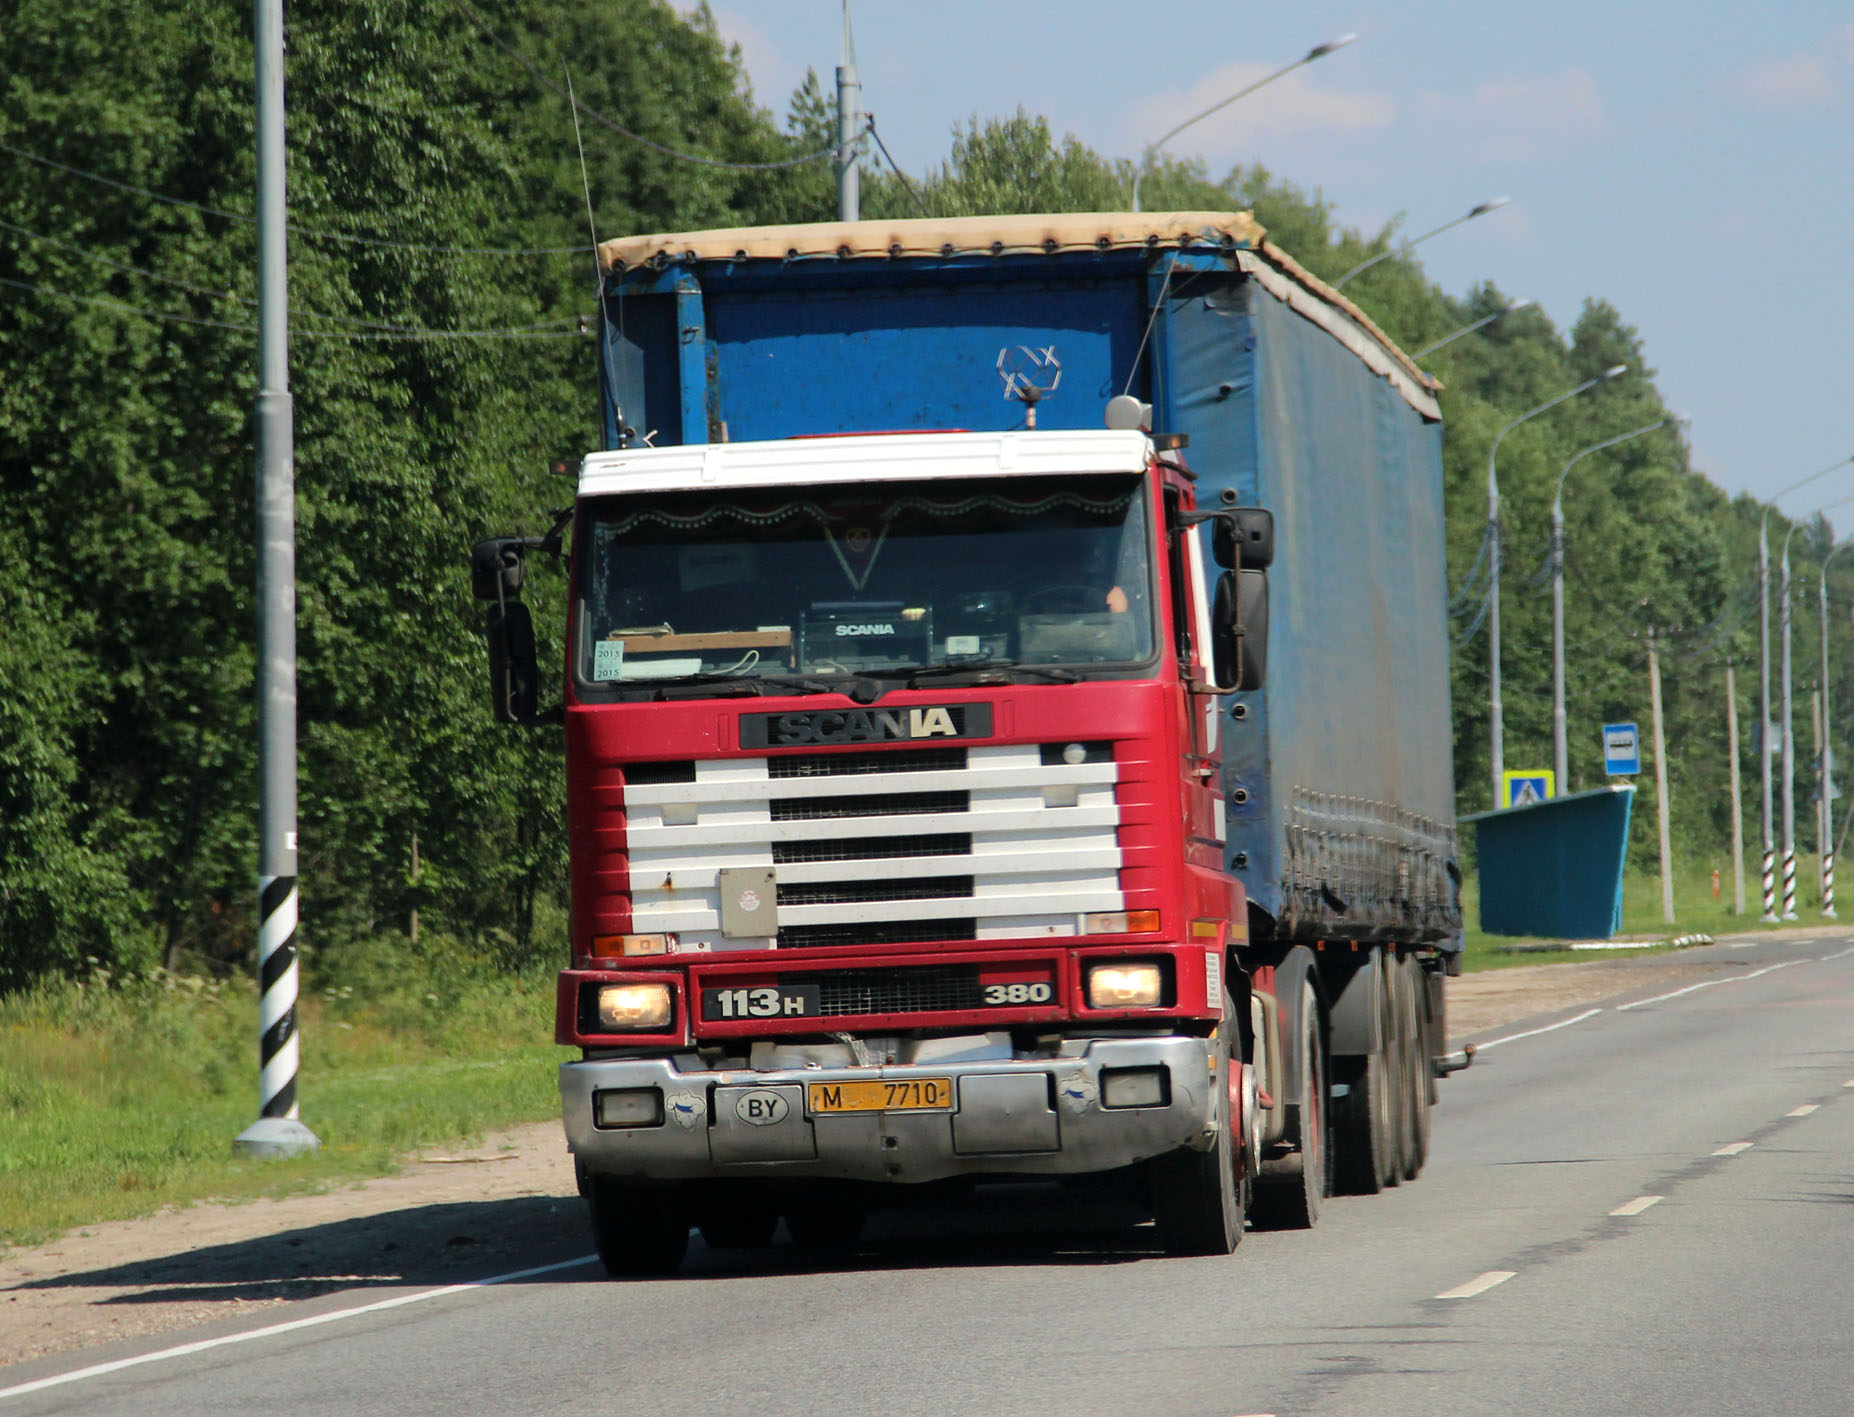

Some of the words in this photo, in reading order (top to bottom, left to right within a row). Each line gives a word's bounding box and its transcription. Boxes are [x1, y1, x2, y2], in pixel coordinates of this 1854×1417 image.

[835, 624, 895, 636] SCANIA
[598, 650, 620, 658] 2015
[598, 670, 619, 678] 2015
[777, 707, 958, 744] SCANIA
[984, 983, 1051, 1004] 380
[823, 1086, 842, 1108] M
[884, 1082, 937, 1106] 7710
[748, 1099, 777, 1117] BY
